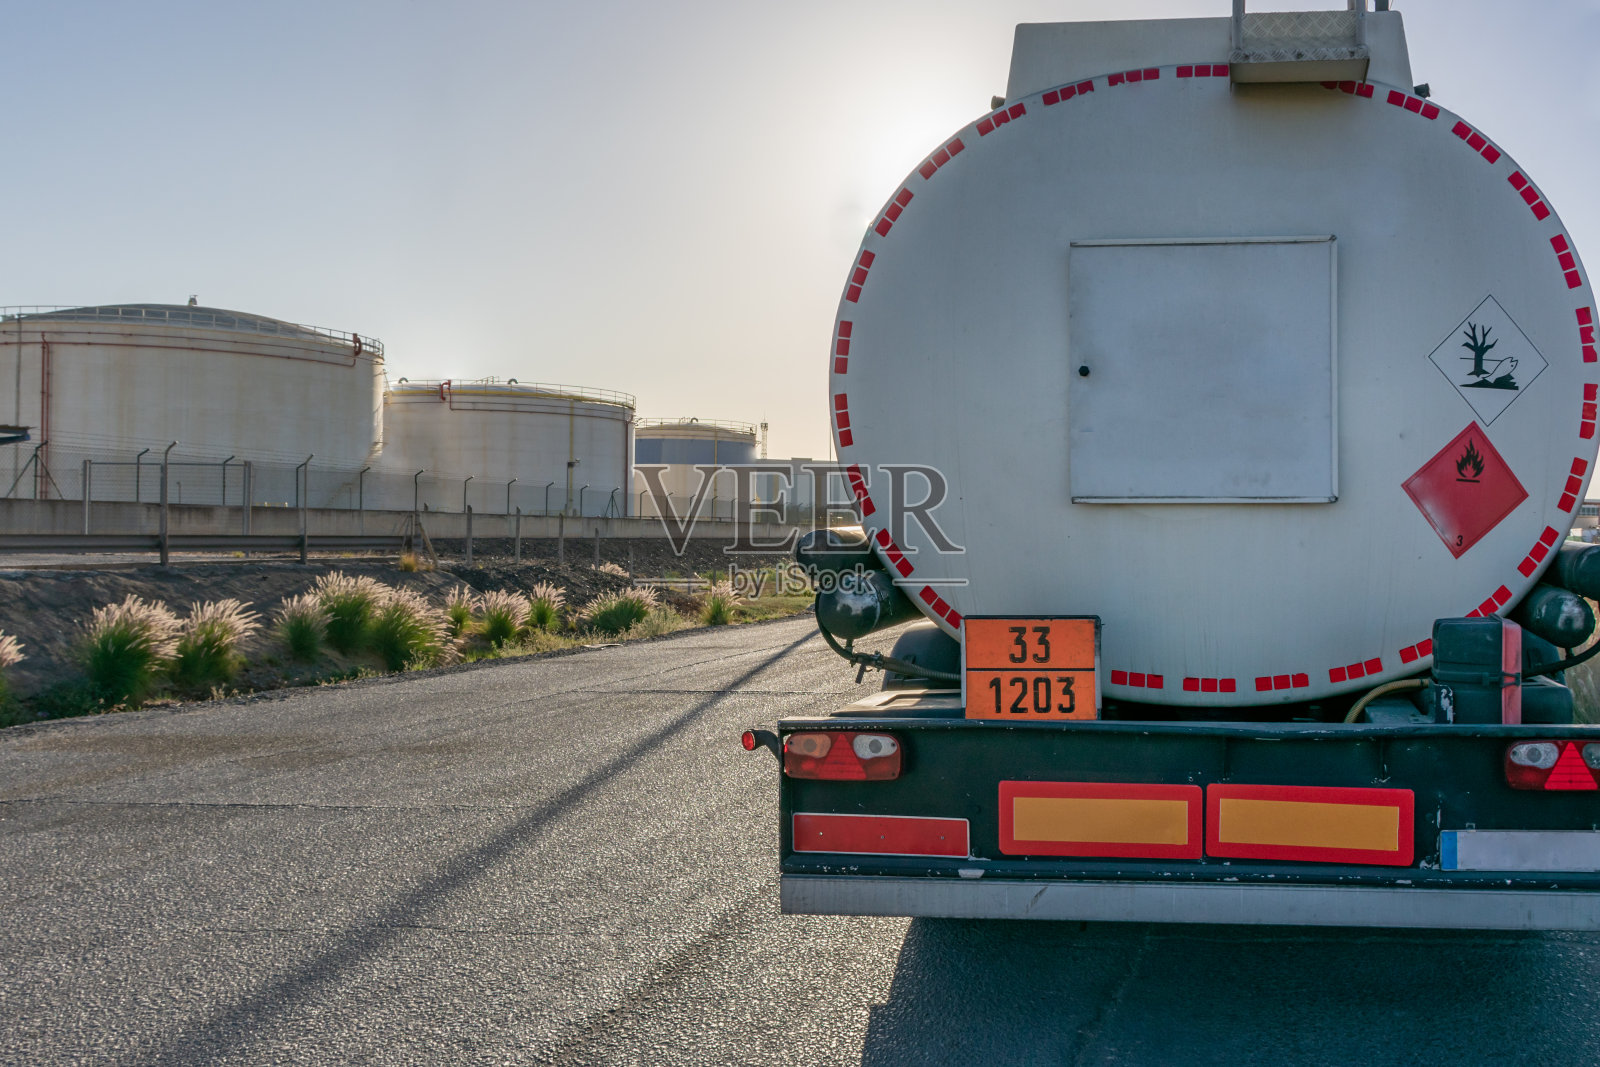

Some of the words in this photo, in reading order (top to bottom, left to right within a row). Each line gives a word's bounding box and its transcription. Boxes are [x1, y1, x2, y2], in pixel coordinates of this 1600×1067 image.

[1456, 535, 1463, 546] 3
[1009, 626, 1050, 663] 33
[989, 677, 1075, 714] 1203
